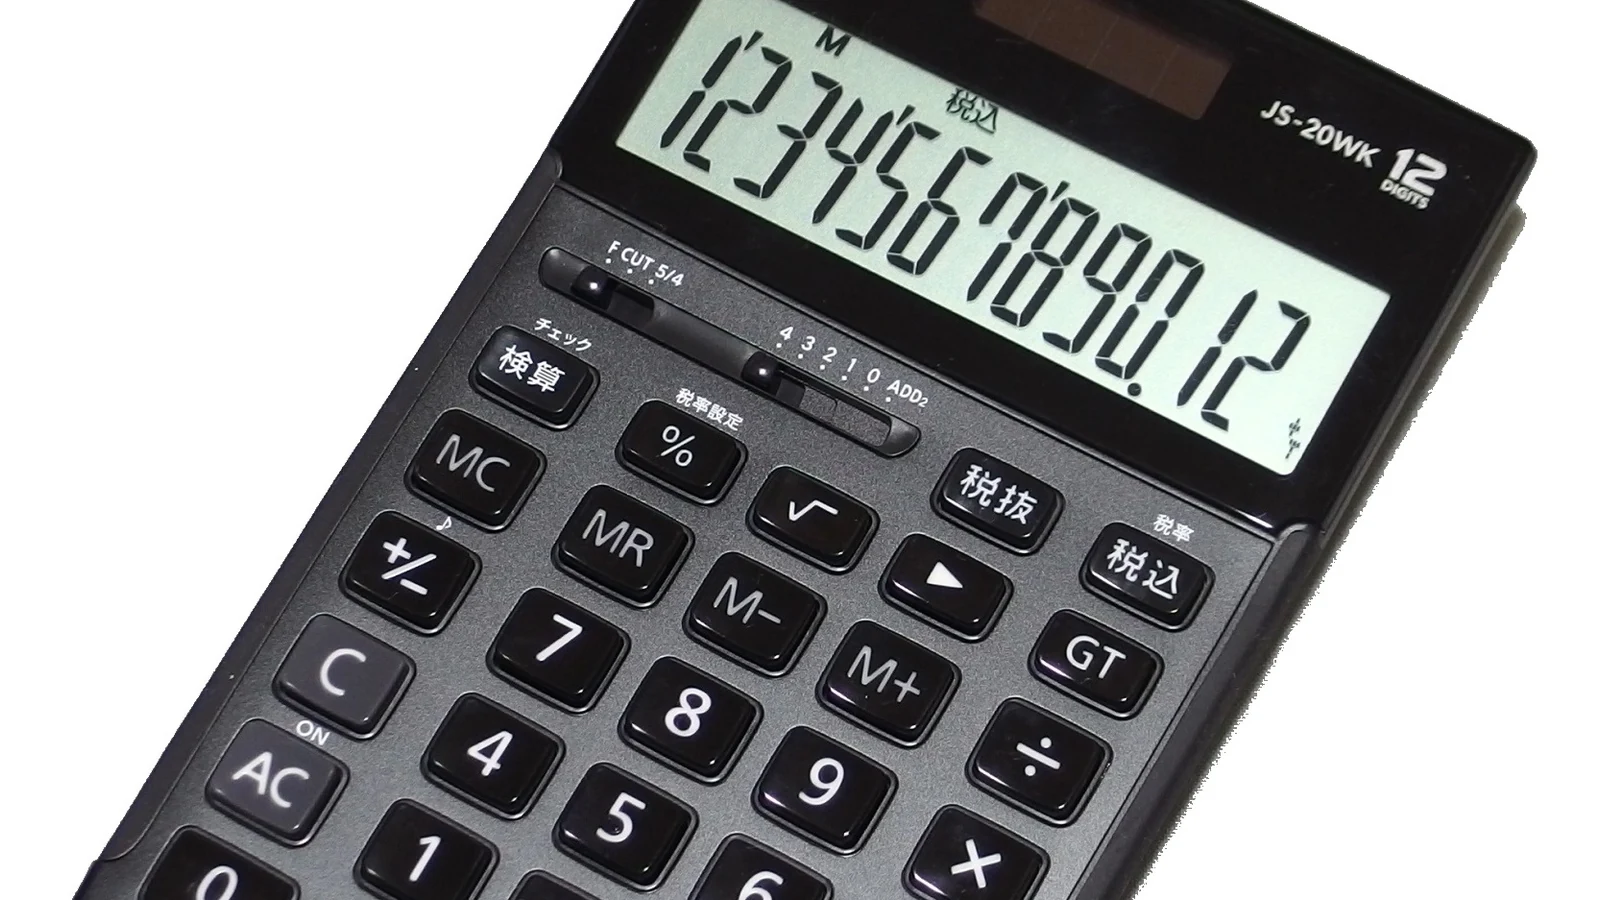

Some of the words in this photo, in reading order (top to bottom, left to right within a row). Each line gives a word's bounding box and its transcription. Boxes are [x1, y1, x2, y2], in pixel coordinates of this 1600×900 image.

[814, 24, 852, 57] M
[946, 87, 1001, 135] 税込
[1260, 101, 1381, 168] JS-20WK
[1379, 178, 1431, 209] DIGITS
[1386, 148, 1448, 197] 12
[607, 240, 620, 254] F
[620, 247, 656, 272] CUT
[654, 263, 685, 287] 5/4
[534, 317, 592, 352] チェック
[779, 326, 794, 341] 4
[800, 335, 816, 352] 3
[822, 346, 838, 362] 2
[846, 357, 858, 373] 1
[866, 367, 881, 384] 0
[498, 344, 567, 393] 検算
[675, 387, 744, 432] 税率設定
[436, 434, 511, 493] MC
[660, 425, 695, 467] %
[959, 464, 1039, 526] 税抜
[582, 507, 656, 568] MR
[1152, 513, 1196, 543] 税率
[1106, 538, 1182, 600] 税込
[535, 613, 584, 662] 7
[1065, 634, 1127, 681] GT
[319, 648, 367, 697] C
[846, 645, 922, 703] M+
[295, 719, 331, 746] ON
[664, 687, 712, 738] 8
[467, 730, 513, 777] 4
[231, 751, 310, 809] AC
[798, 757, 845, 806] 9
[596, 792, 646, 843] 5
[195, 865, 238, 900] 0
[409, 835, 441, 882] 1
